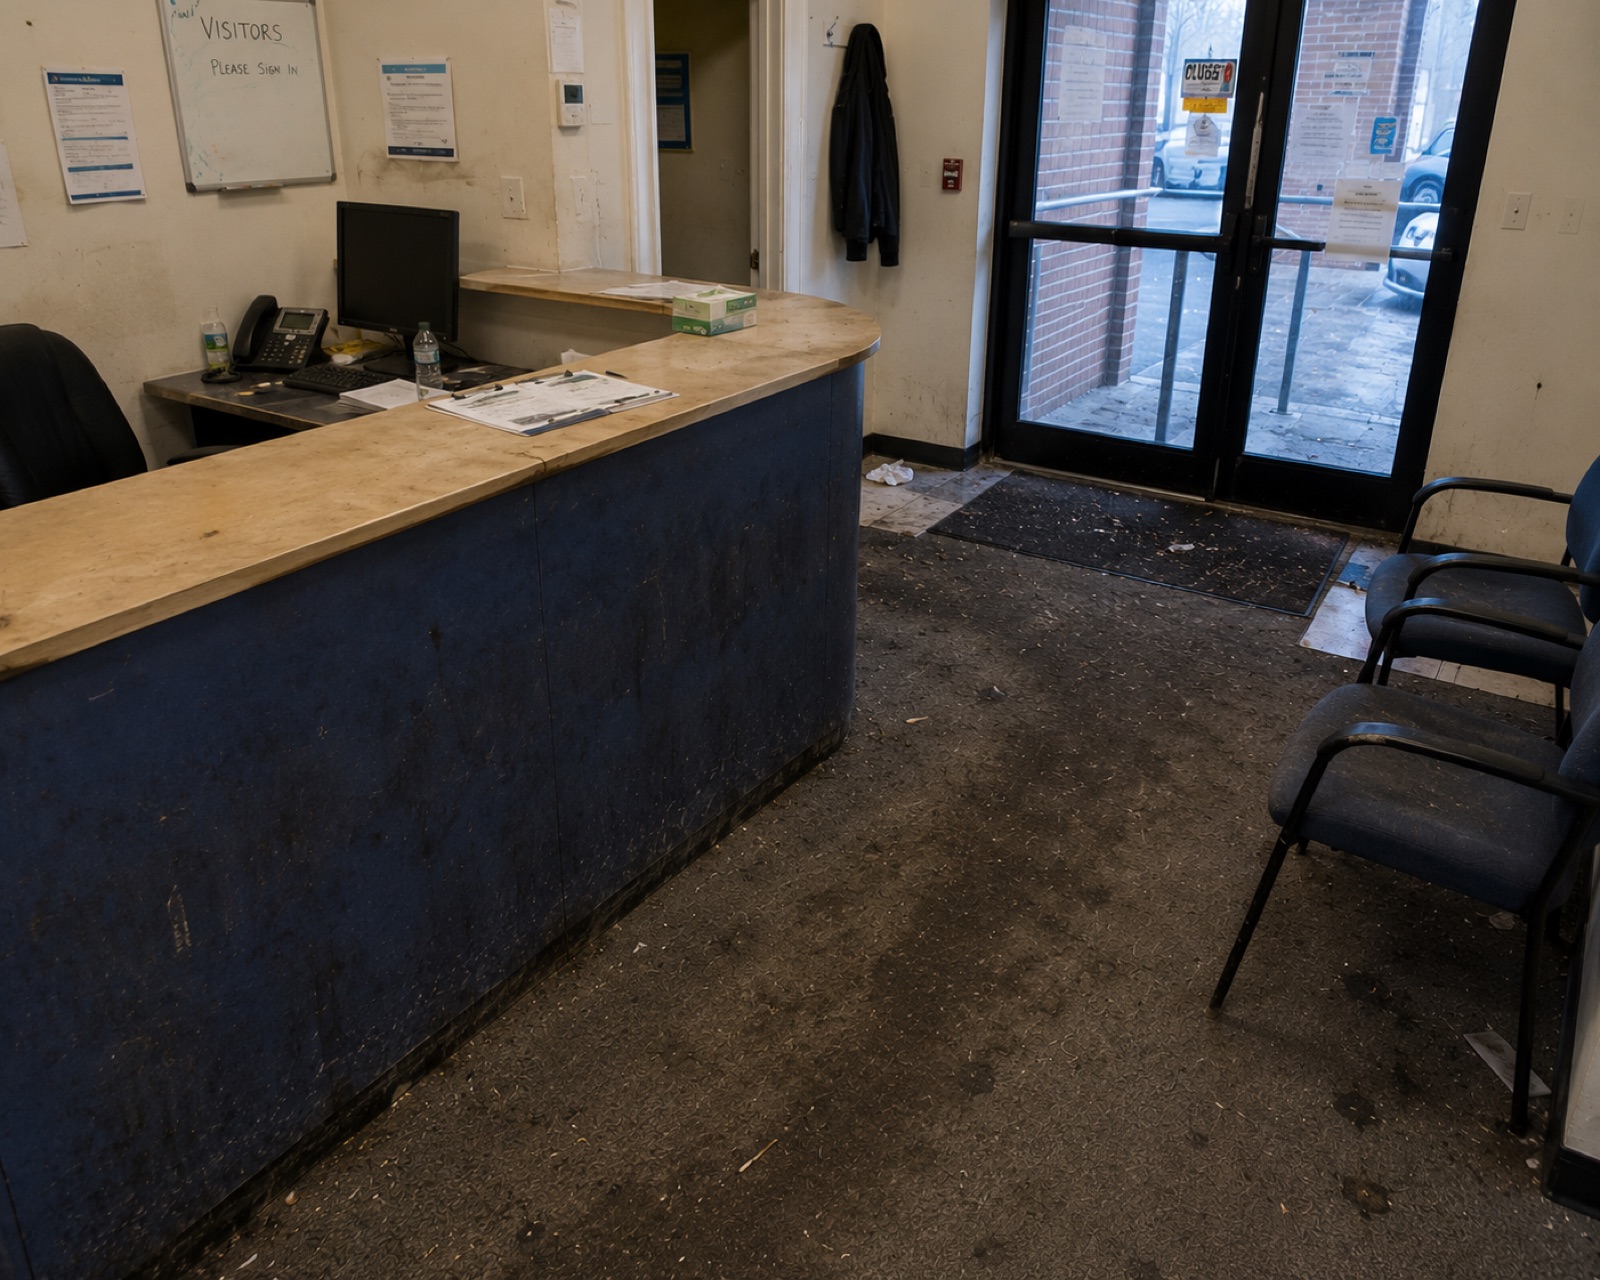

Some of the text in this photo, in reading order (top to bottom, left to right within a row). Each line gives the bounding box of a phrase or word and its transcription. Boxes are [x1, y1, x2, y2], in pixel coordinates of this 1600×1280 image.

[200, 16, 283, 41] VISITORS
[210, 58, 250, 76] PLEASE
[288, 64, 299, 75] IN
